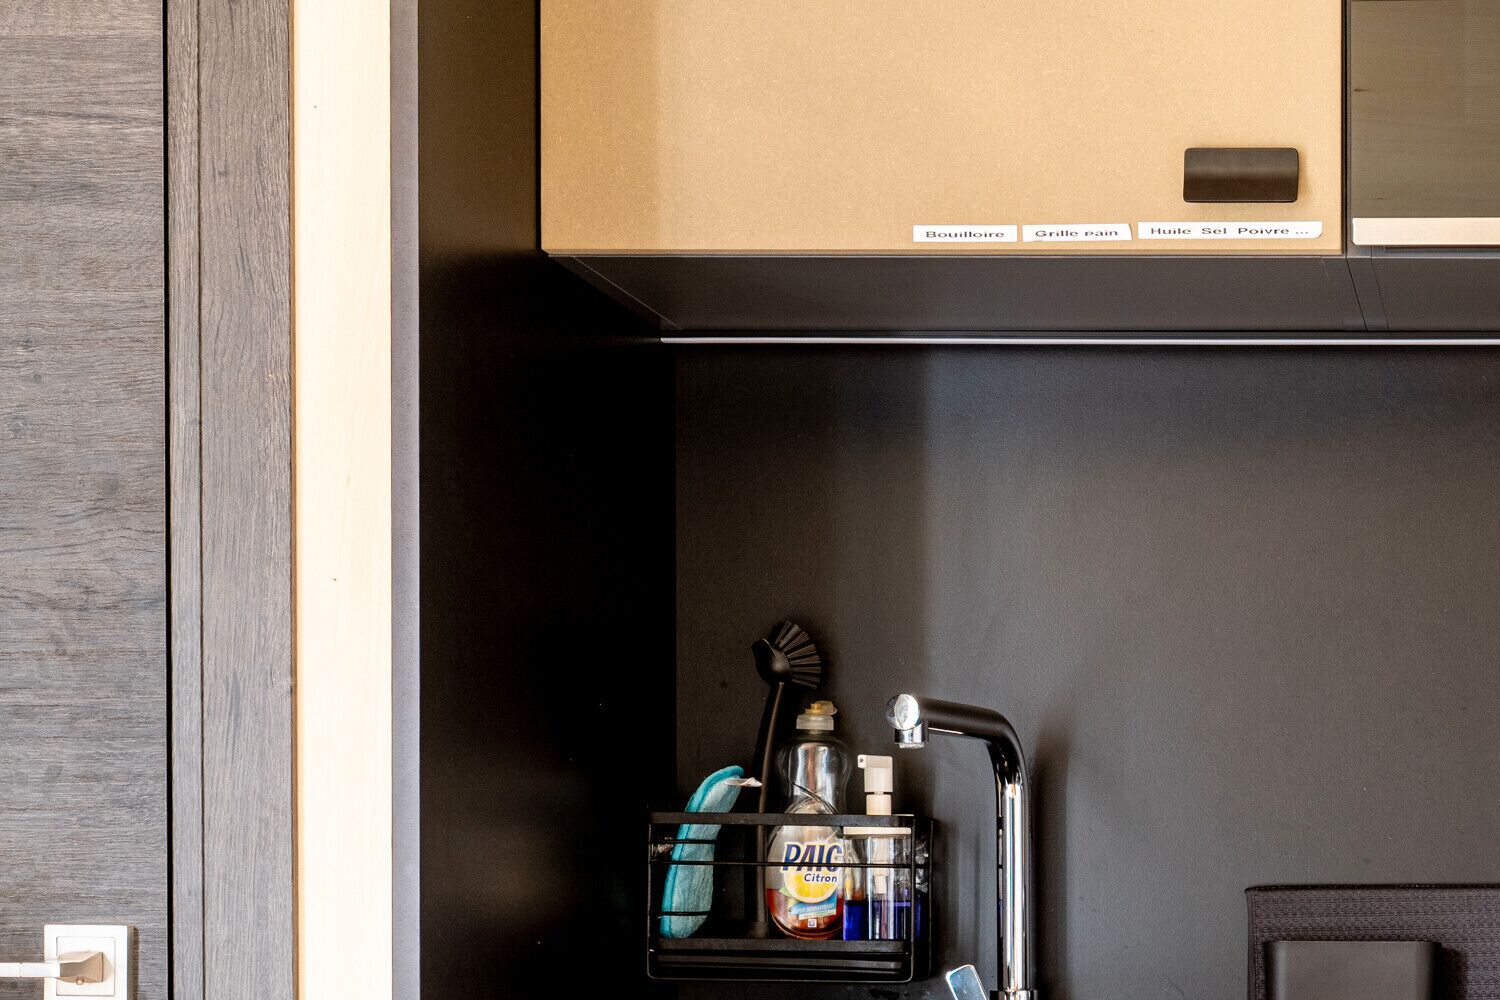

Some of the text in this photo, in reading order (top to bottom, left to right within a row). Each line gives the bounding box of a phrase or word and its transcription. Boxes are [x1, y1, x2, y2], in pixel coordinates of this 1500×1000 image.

[1035, 230, 1079, 238] Grille
[1150, 227, 1192, 235] Huile
[1201, 227, 1227, 235] Sel
[1237, 227, 1290, 235] Poivre
[782, 843, 843, 872] PAIC
[804, 873, 838, 882] Citron
